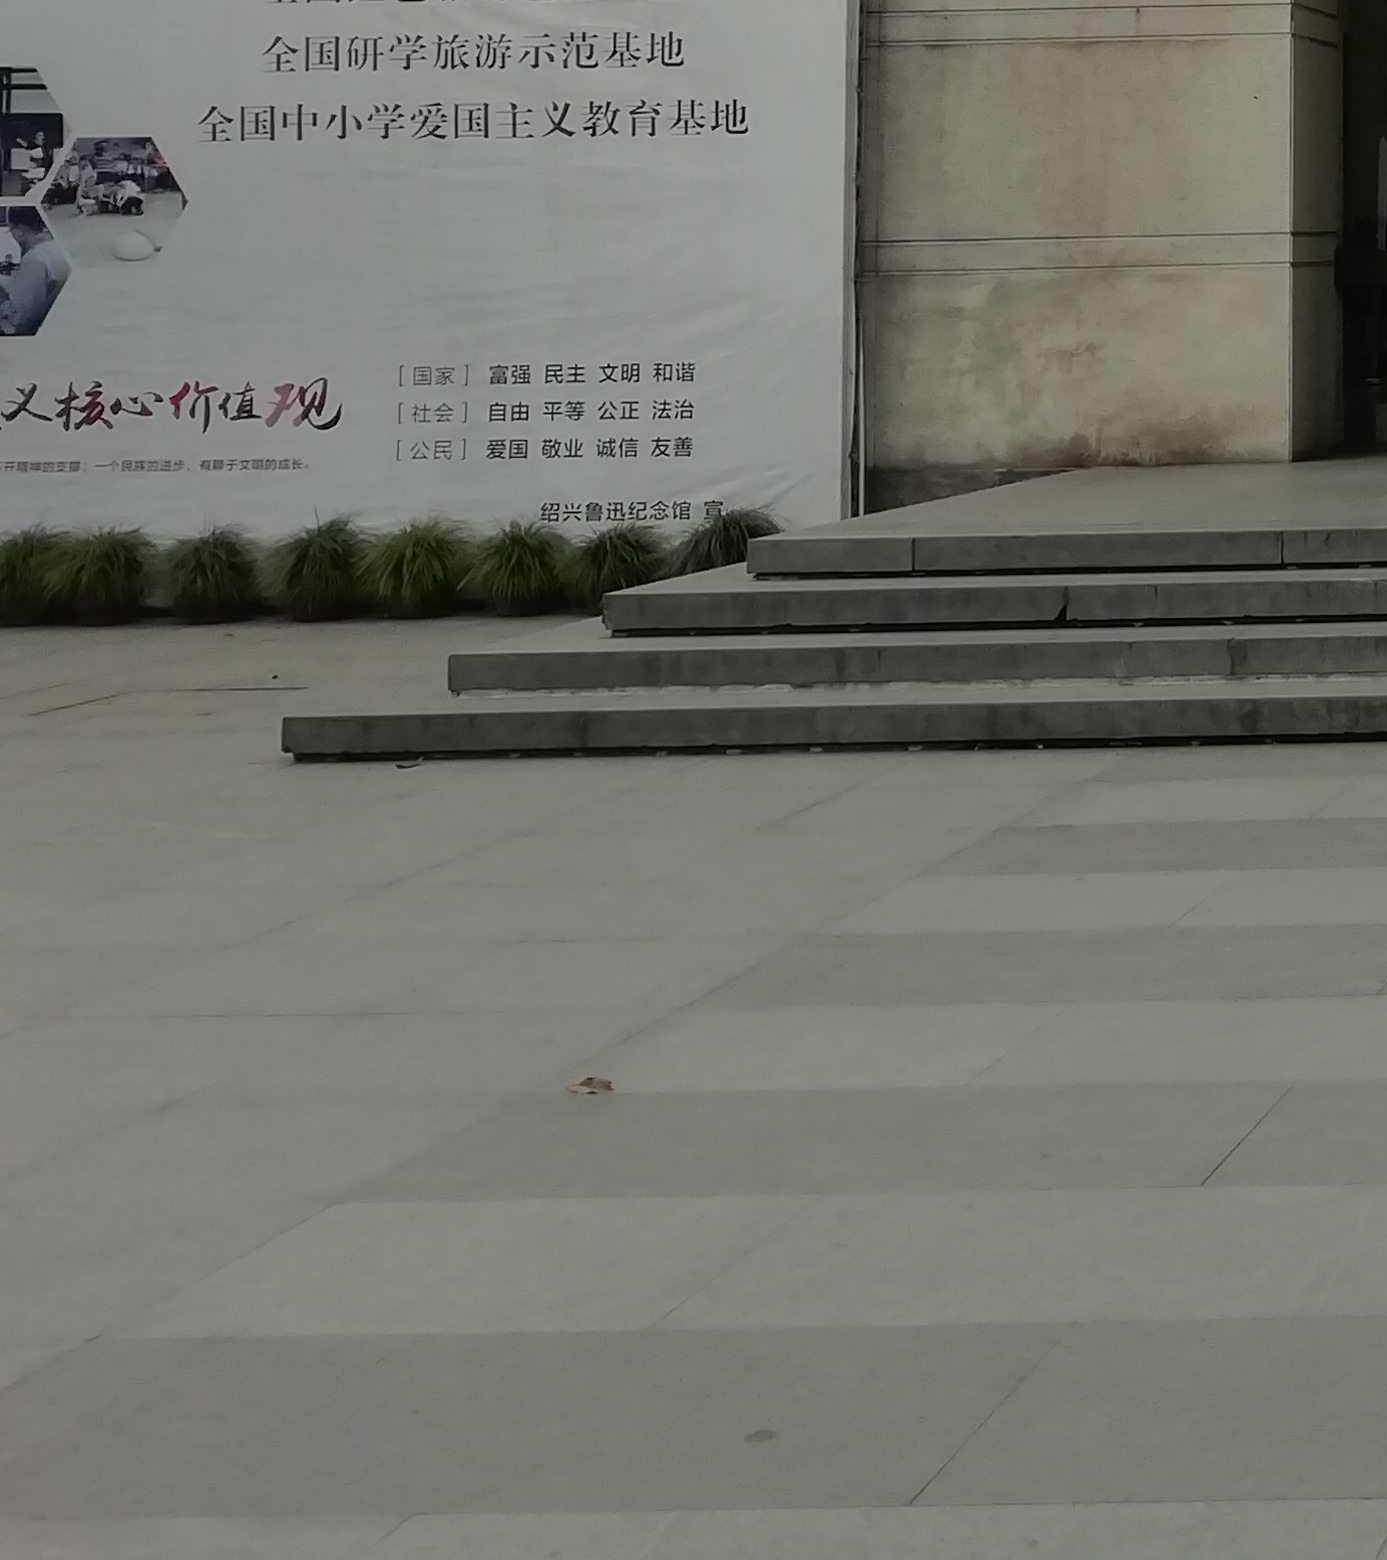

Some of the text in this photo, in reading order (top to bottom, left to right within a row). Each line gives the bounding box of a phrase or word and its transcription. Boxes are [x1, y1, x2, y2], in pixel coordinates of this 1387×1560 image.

[261, 31, 685, 74] 全国研学旅游示范基地
[198, 98, 750, 144] 全国中小学爱国主义教育基地
[488, 364, 531, 385] 富强
[544, 364, 586, 384] 民主
[598, 363, 641, 384] 文明
[653, 362, 695, 383] 和谐
[0, 377, 342, 434] 义核心价值观
[488, 402, 530, 422] 自由
[543, 401, 586, 422] 平等
[597, 400, 640, 421] 公正
[652, 399, 694, 420] 法治
[485, 439, 528, 460] 爱国
[541, 438, 583, 459] 敬业
[595, 437, 638, 459] 诚信
[650, 437, 693, 458] 友善
[540, 500, 724, 523] 绍兴鲁迅纪念馆 宣
